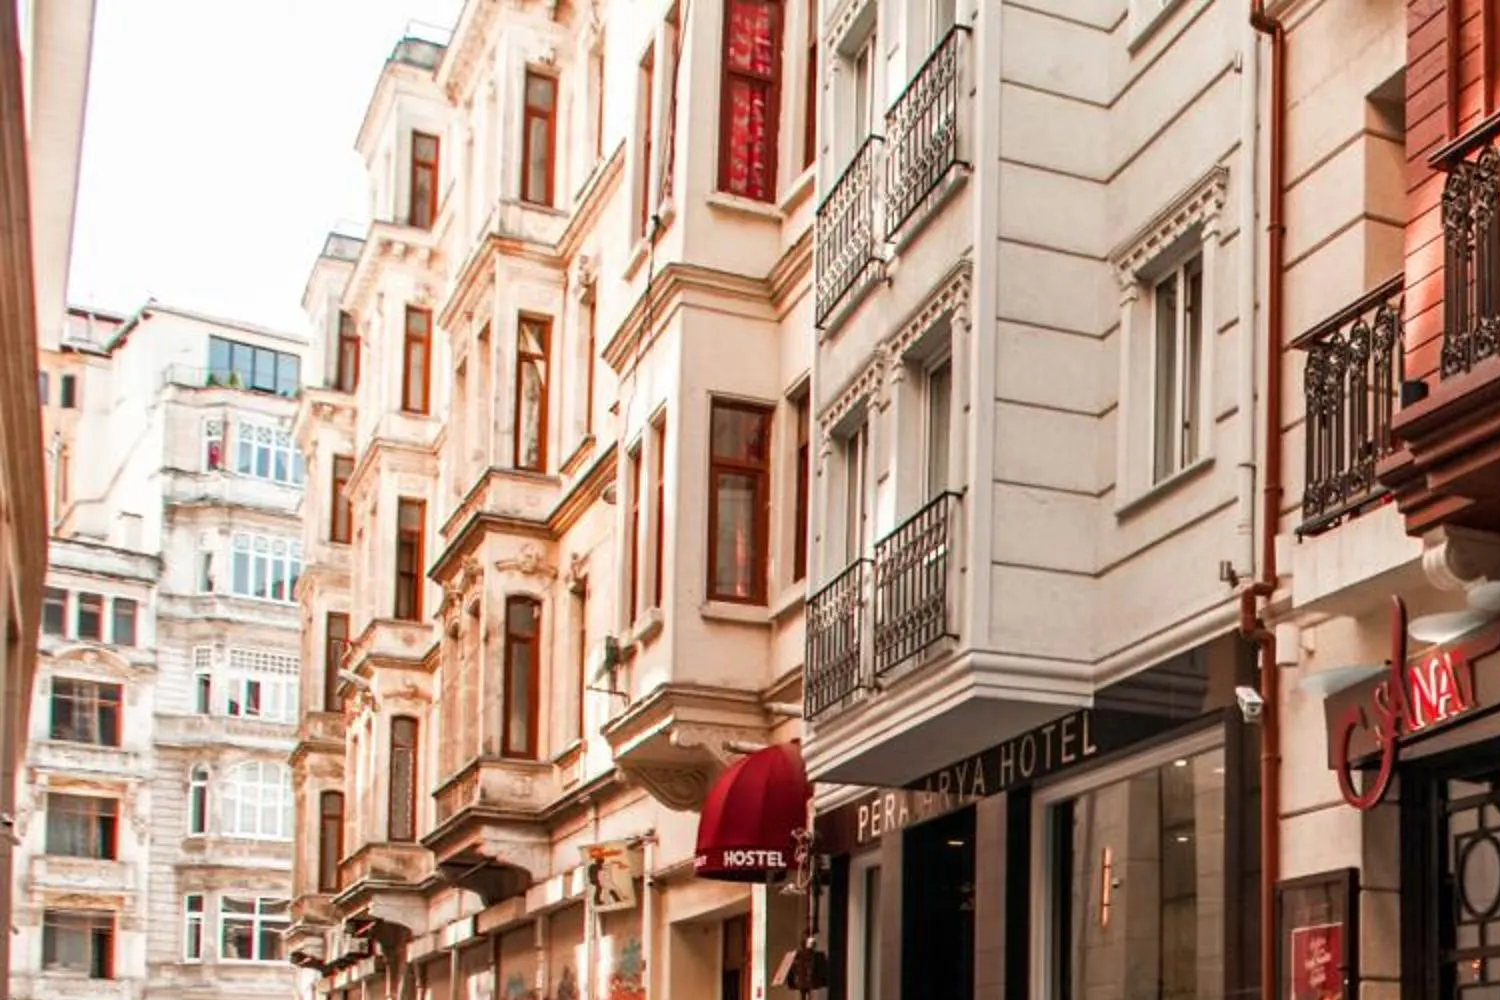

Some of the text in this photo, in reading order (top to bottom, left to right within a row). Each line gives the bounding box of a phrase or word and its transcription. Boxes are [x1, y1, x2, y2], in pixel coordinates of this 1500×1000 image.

[857, 710, 1098, 843] PERA ARYA HOTEL
[722, 849, 787, 868] HOSTEL
